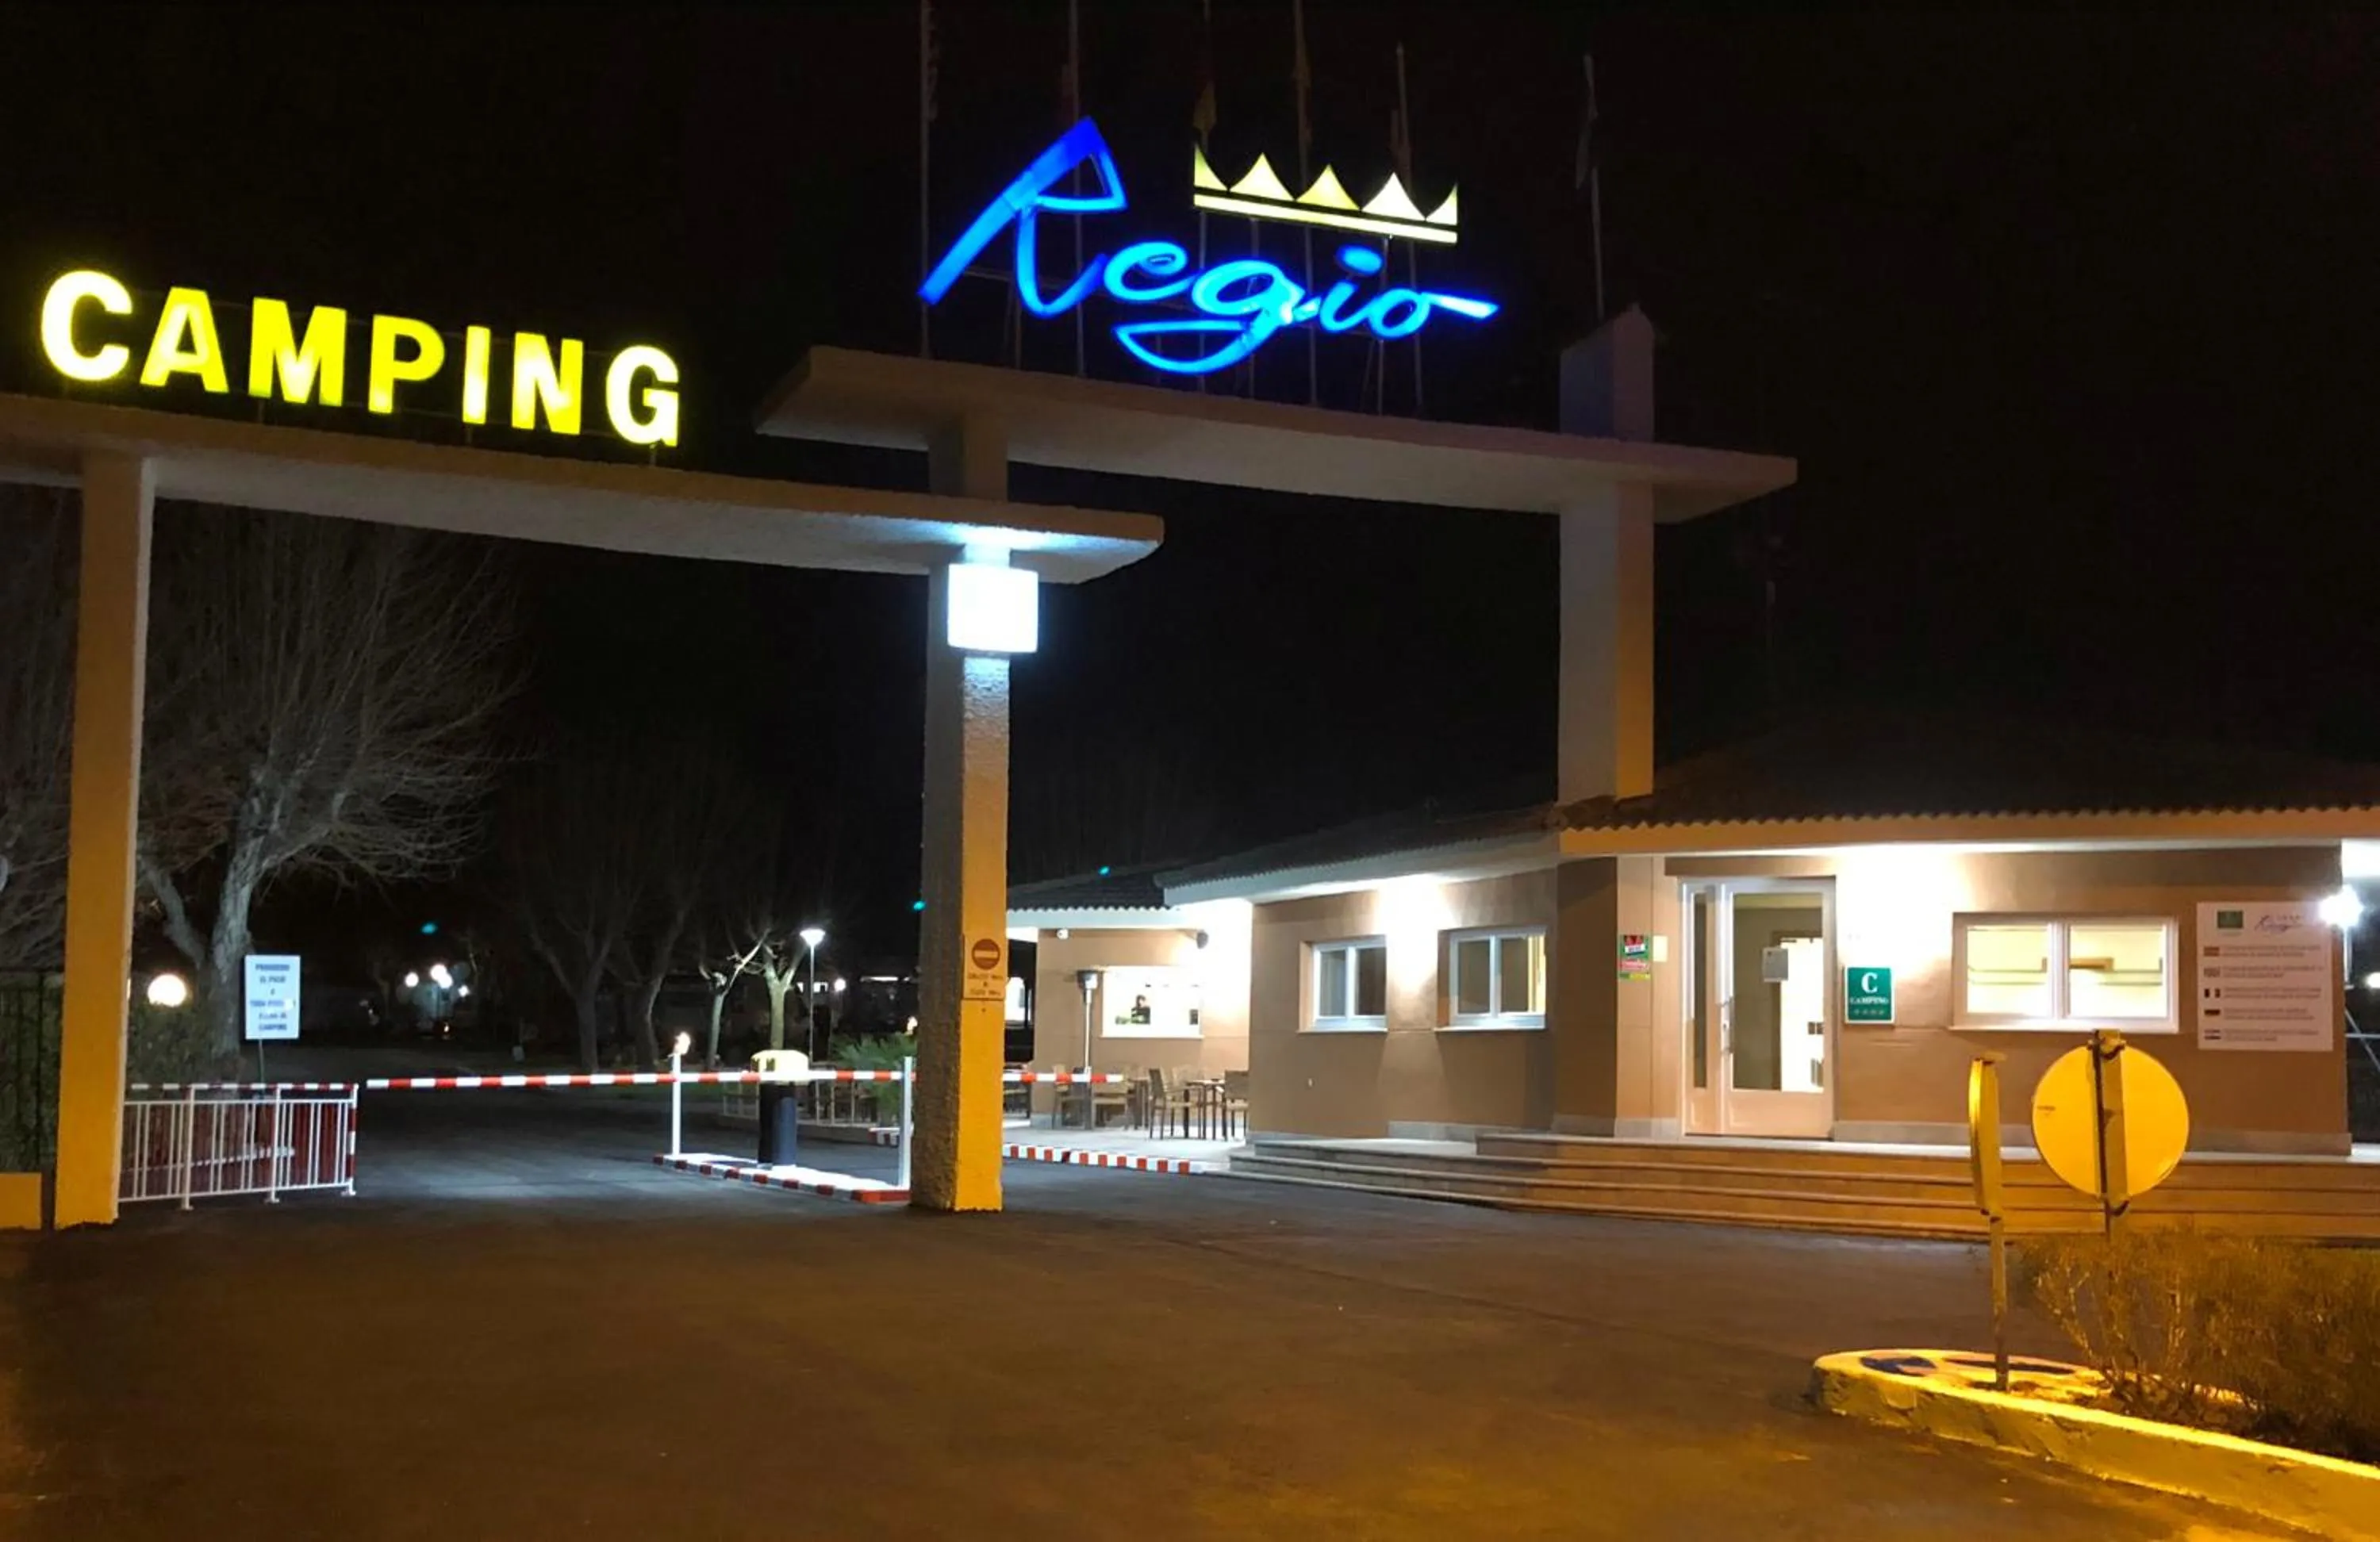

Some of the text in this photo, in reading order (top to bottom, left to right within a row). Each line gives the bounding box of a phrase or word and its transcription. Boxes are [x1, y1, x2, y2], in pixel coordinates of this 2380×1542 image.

[917, 116, 1500, 376] Regio
[40, 270, 680, 448] CAMPING
[1860, 972, 1879, 994] C
